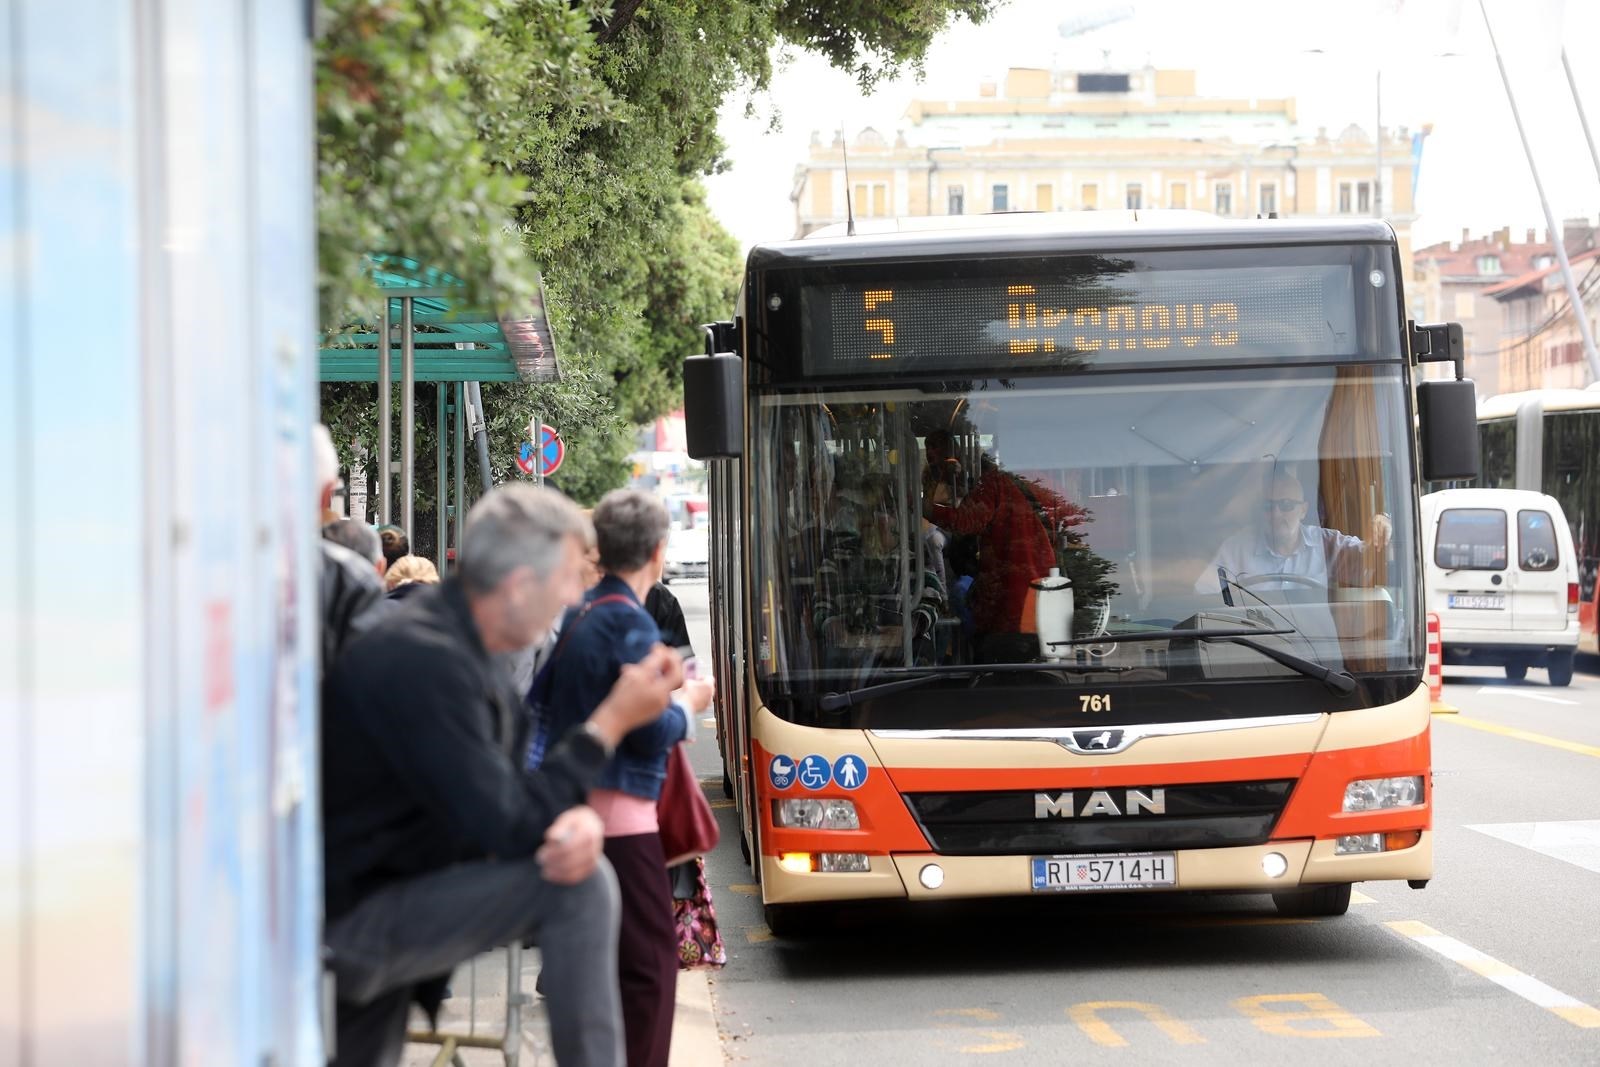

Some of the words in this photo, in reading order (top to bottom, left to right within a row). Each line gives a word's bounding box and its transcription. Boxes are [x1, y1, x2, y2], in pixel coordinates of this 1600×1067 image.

[865, 290, 894, 359] 5
[1080, 694, 1111, 712] 761
[1035, 788, 1165, 818] MAN
[1048, 862, 1070, 883] RI
[1089, 859, 1165, 882] 5714-H
